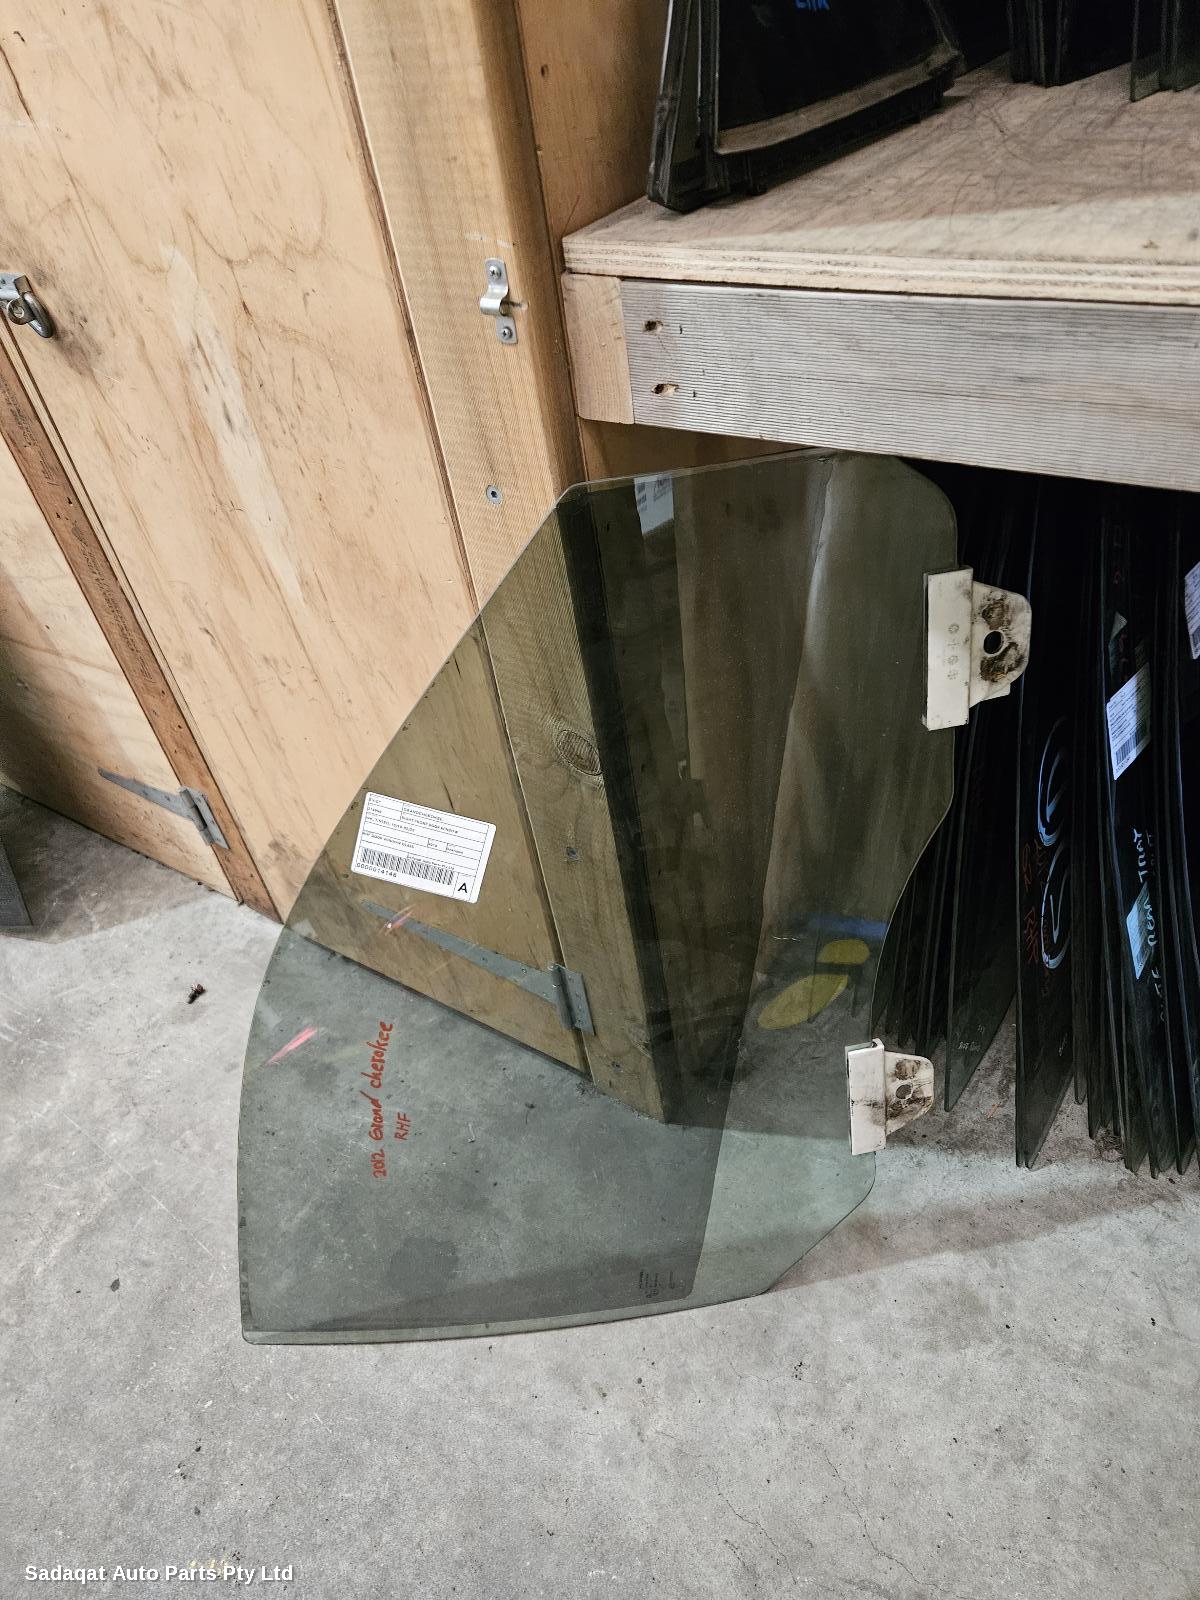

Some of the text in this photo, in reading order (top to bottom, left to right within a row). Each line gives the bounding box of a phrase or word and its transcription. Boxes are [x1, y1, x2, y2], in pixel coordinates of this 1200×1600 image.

[458, 882, 468, 894] A
[394, 1111, 411, 1141] RHF
[371, 1148, 387, 1179] 2012
